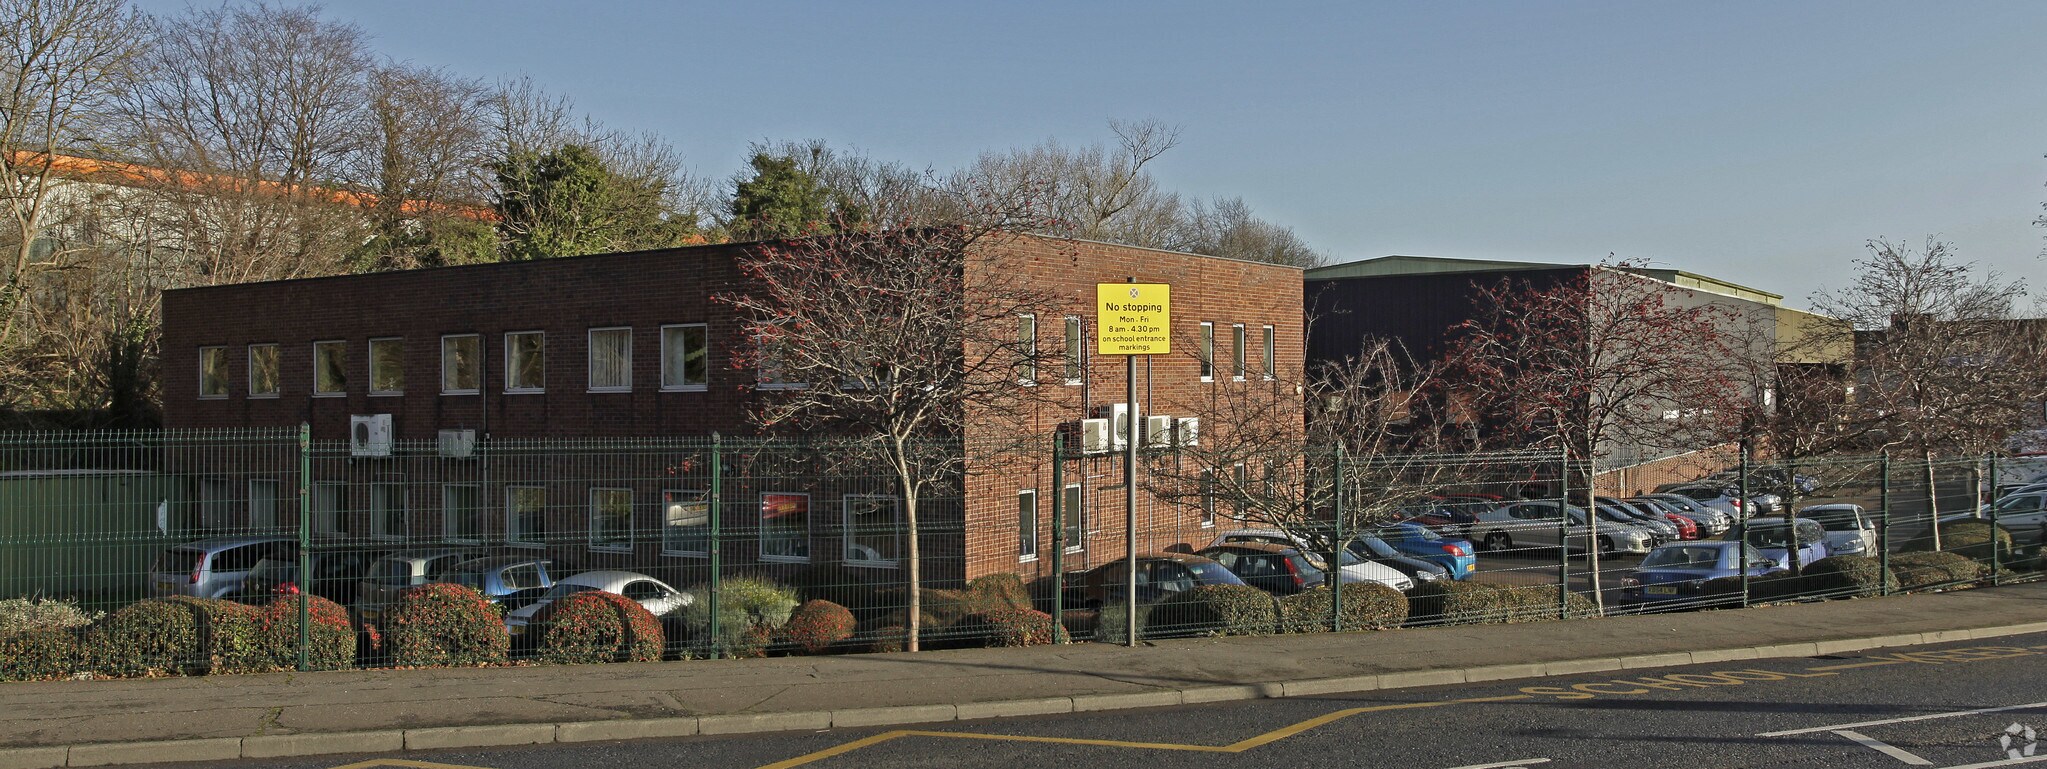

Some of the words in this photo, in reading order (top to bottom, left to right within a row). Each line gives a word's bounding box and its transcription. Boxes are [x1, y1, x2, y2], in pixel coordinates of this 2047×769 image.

[1106, 303, 1120, 311] No
[1123, 303, 1162, 313] stopping
[1519, 669, 1839, 699] SCHOOL
